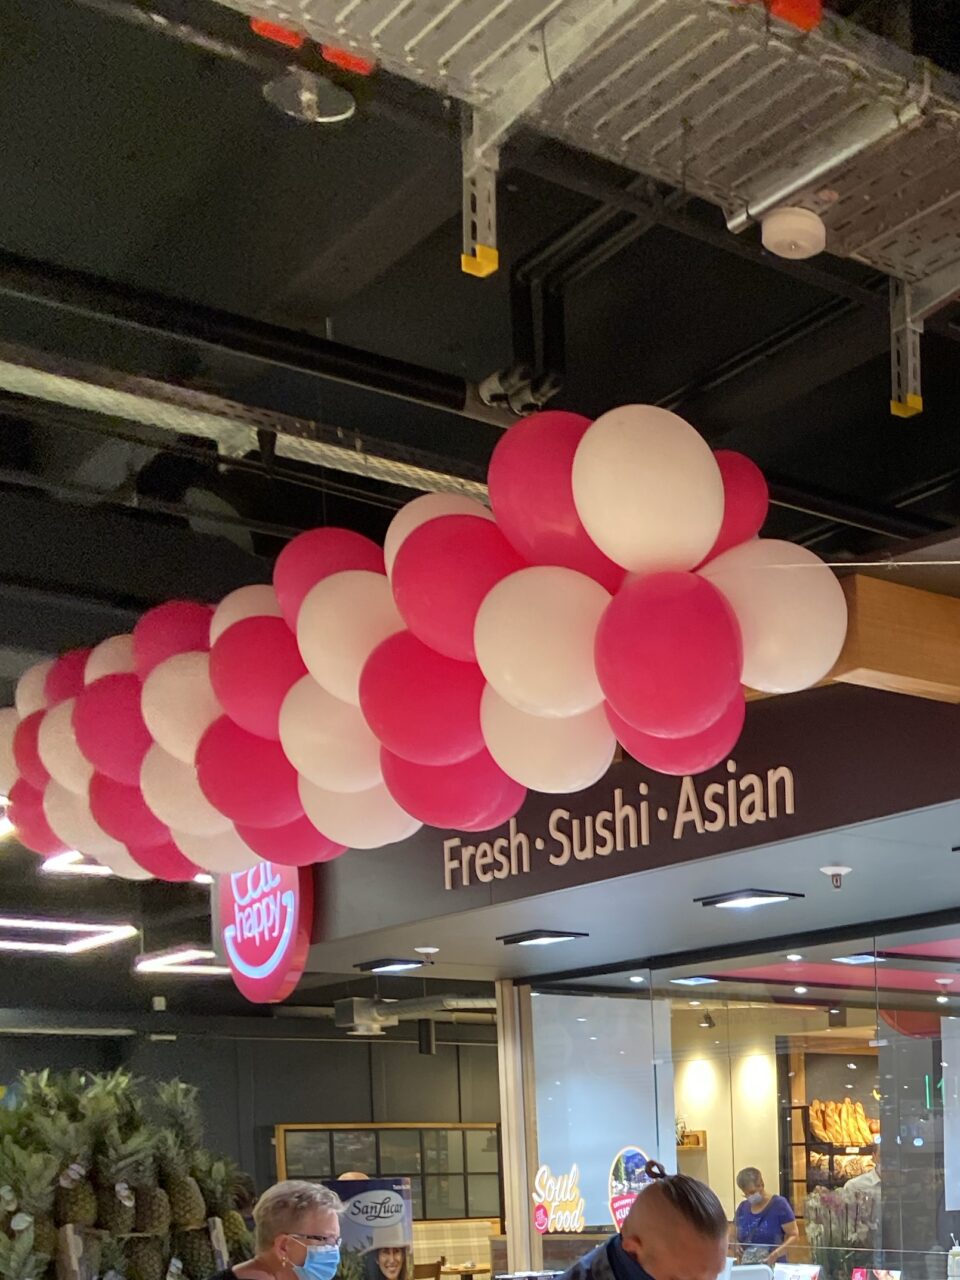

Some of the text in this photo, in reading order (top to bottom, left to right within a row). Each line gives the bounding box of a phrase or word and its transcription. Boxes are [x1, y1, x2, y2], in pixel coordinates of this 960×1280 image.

[443, 759, 795, 890] Fresh Sushi Asian
[234, 890, 281, 946] happy
[531, 1163, 578, 1203] Soul
[351, 1197, 403, 1221] SanLucar
[548, 1198, 585, 1233] Food
